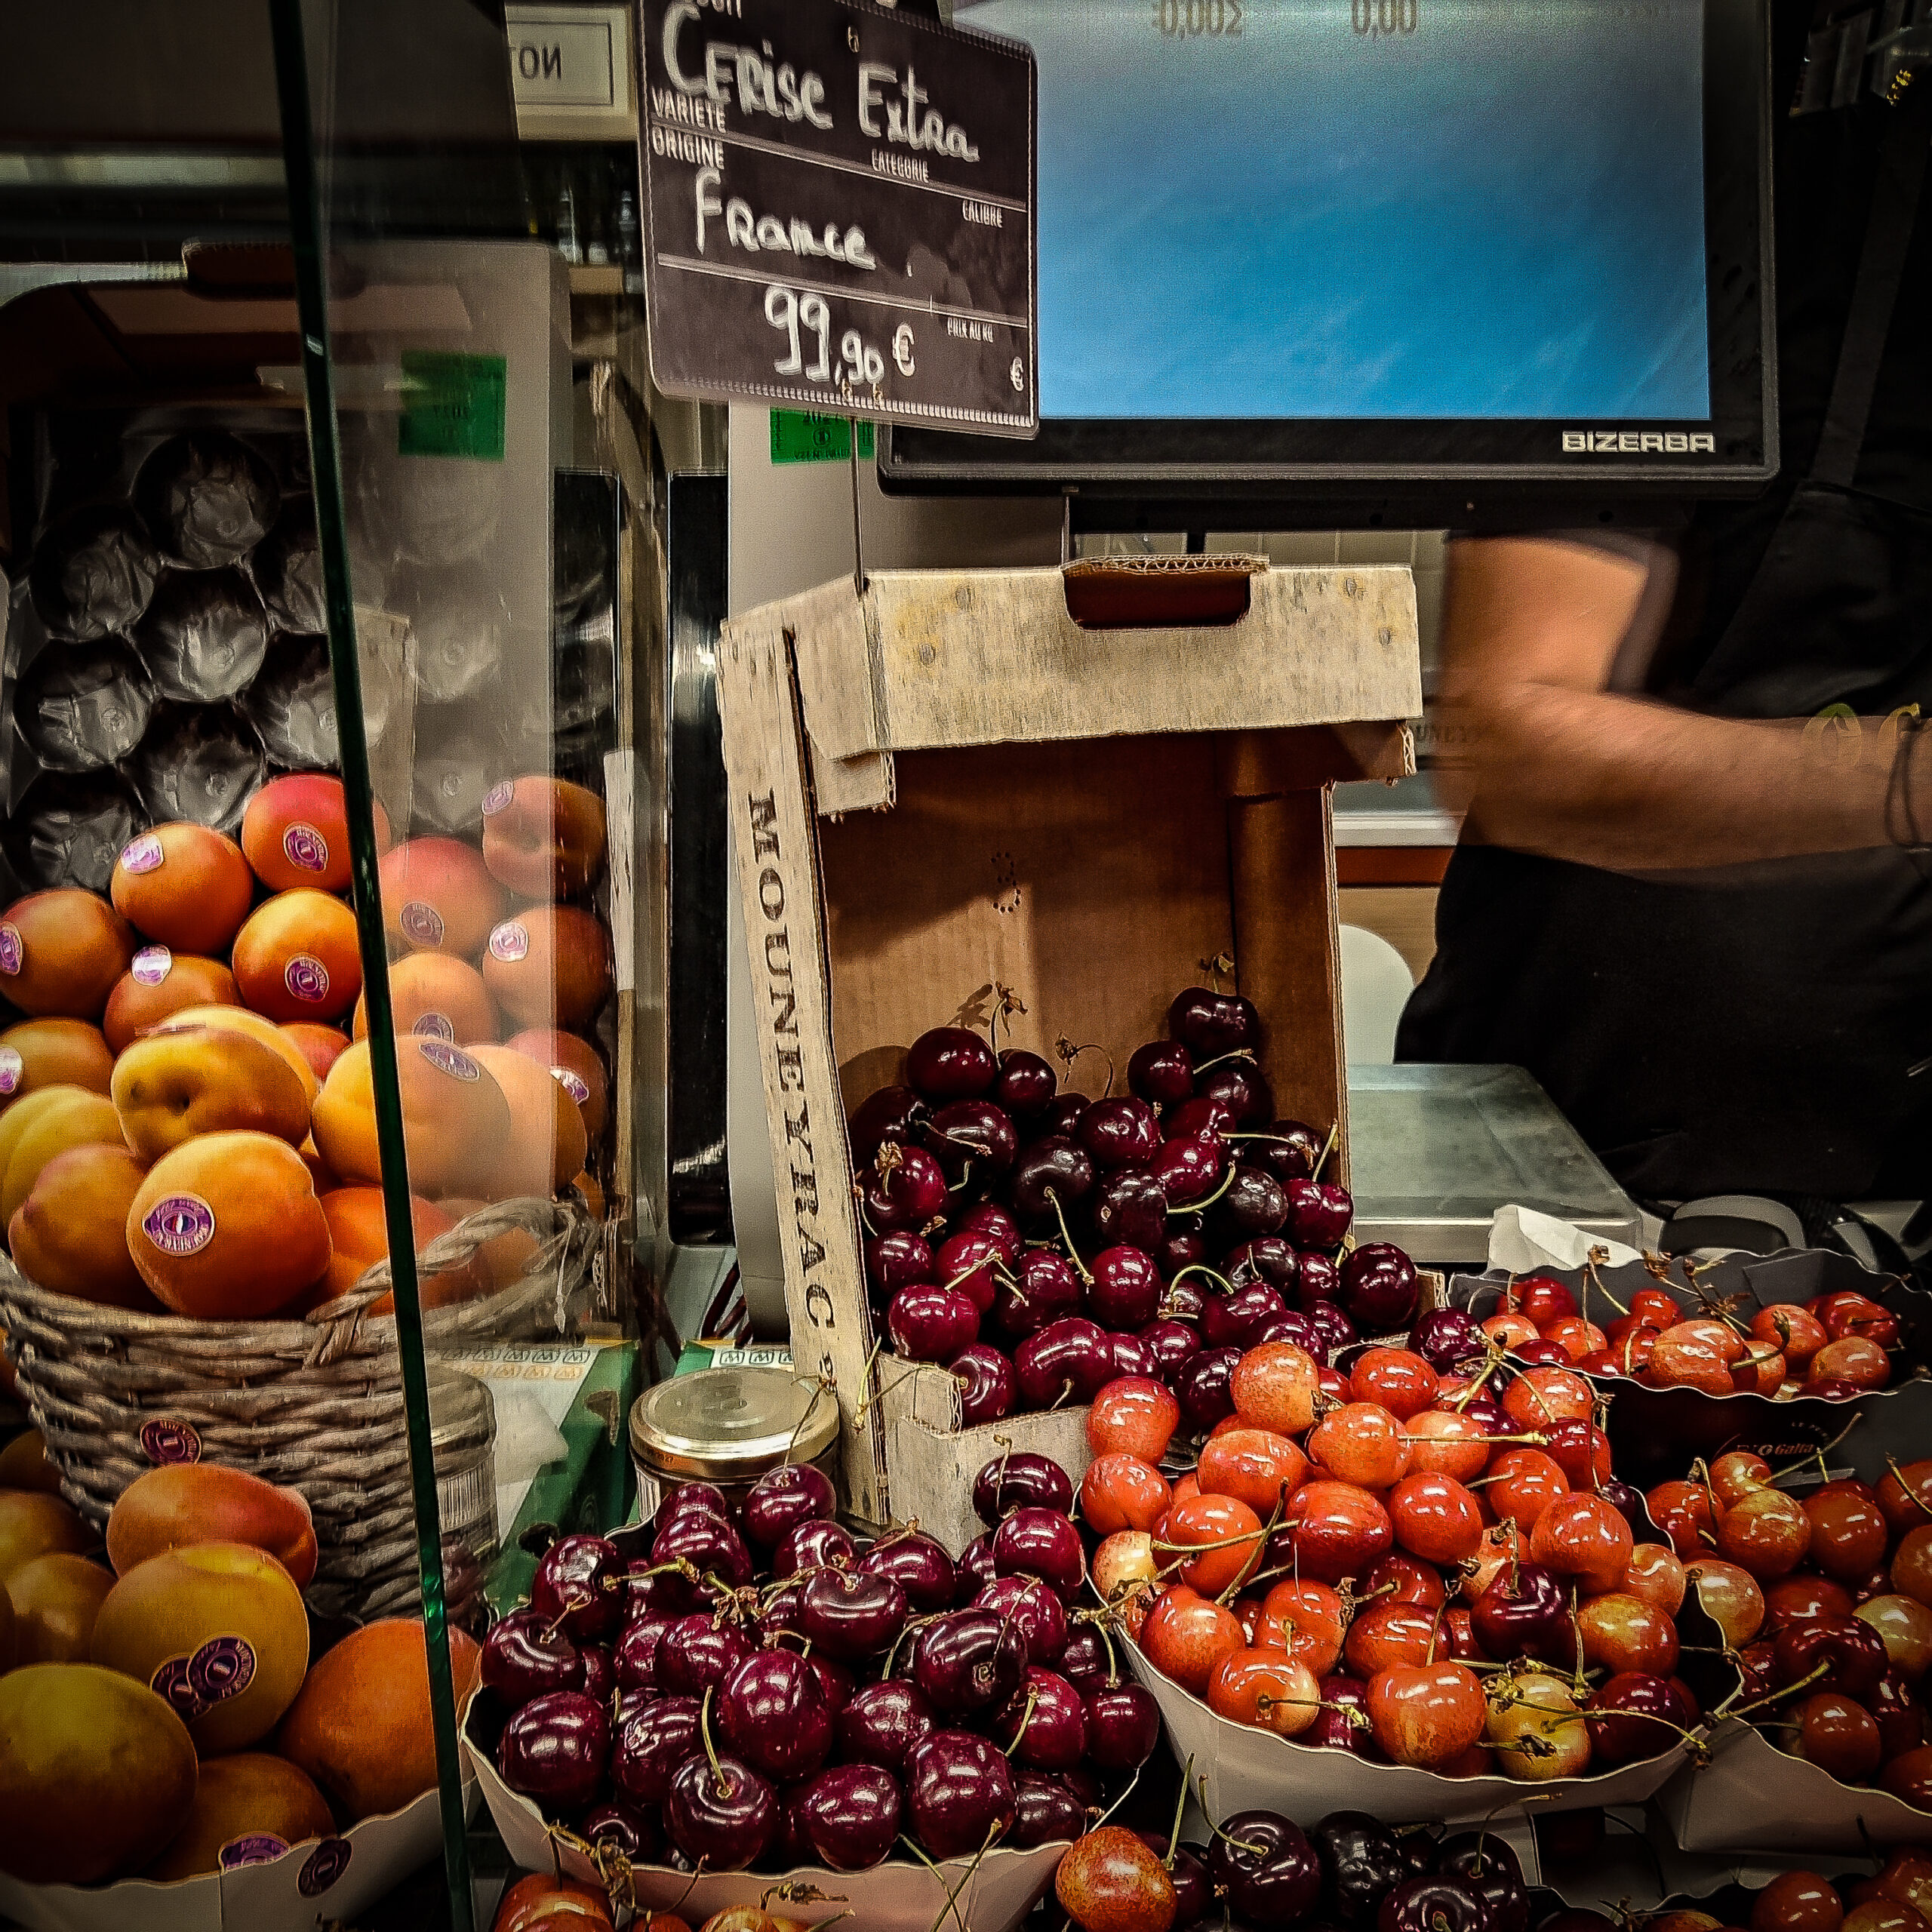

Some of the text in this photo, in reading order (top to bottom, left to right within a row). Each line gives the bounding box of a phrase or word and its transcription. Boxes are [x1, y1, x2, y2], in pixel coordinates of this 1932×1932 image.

[651, 126, 725, 170] ORIGINE
[962, 199, 1003, 228] CALIBRE
[764, 285, 915, 387] 99,90 €
[969, 321, 981, 341] AU
[1010, 356, 1024, 392] €
[1561, 431, 1717, 453] BIZERBA
[748, 786, 835, 1329] MOUNEYRAC
